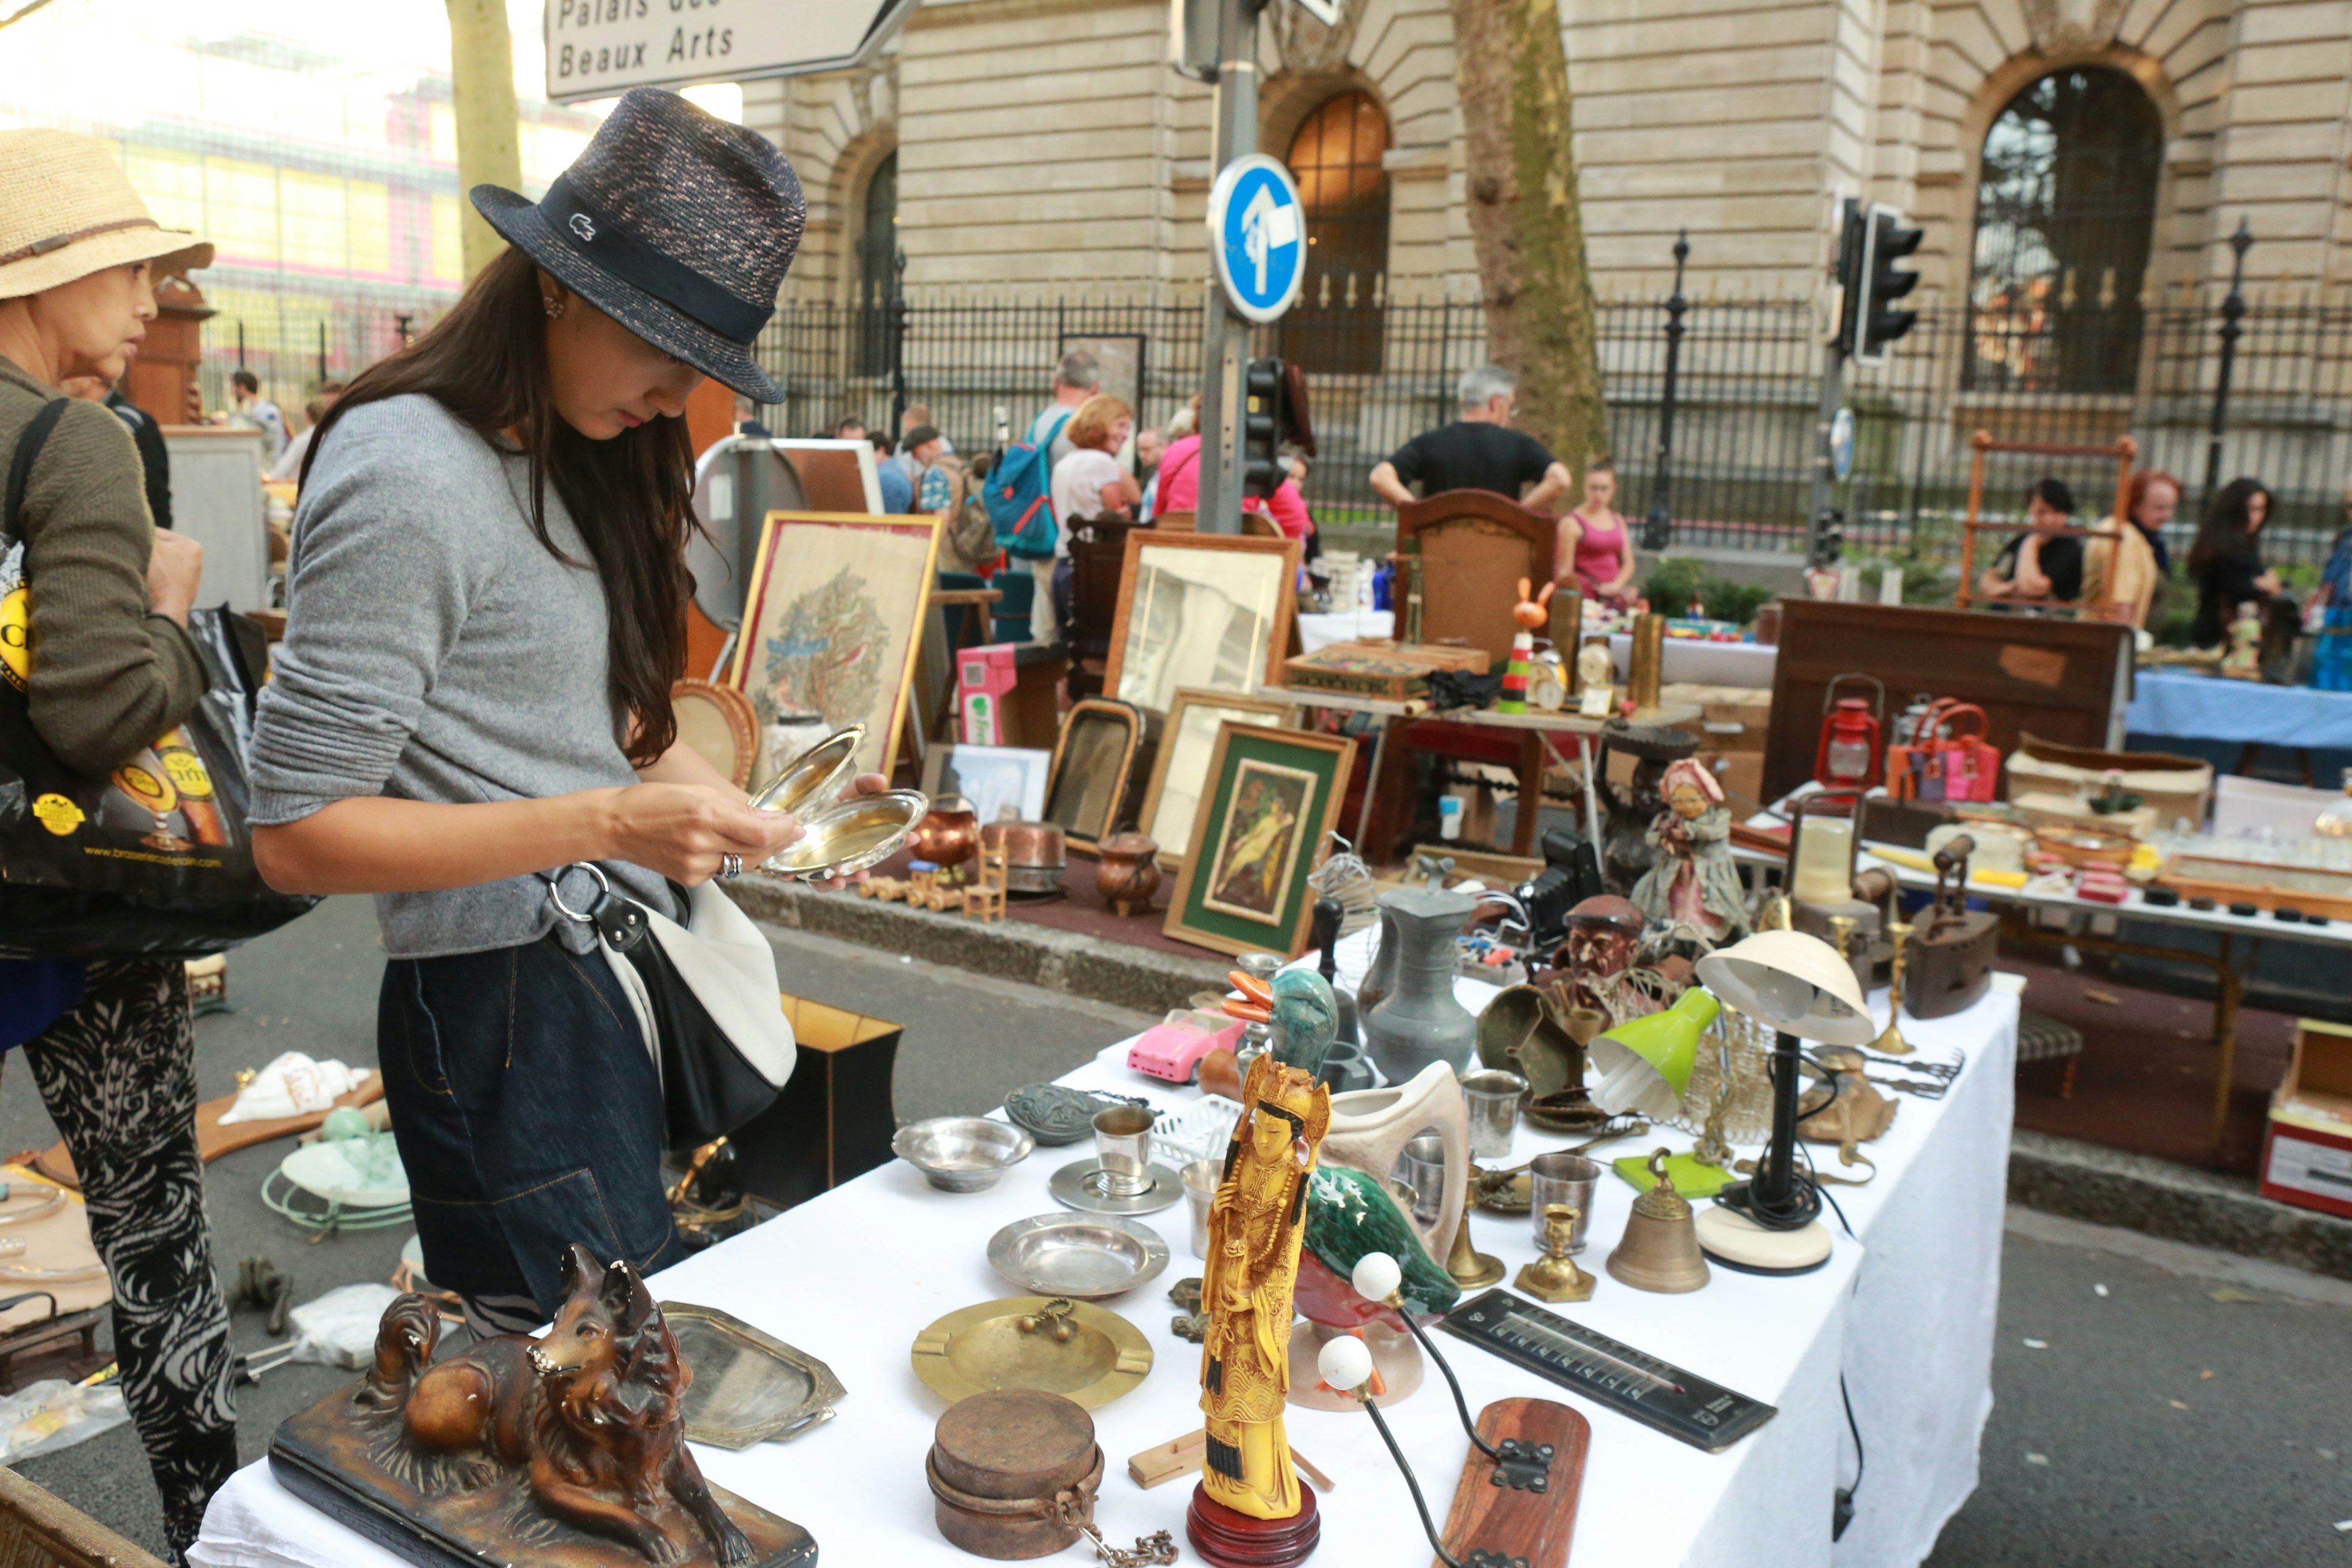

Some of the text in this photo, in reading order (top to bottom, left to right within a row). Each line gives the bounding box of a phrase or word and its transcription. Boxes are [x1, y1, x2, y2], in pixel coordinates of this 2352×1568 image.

[558, 0, 649, 29] Palais
[559, 26, 734, 78] Beaux Arts
